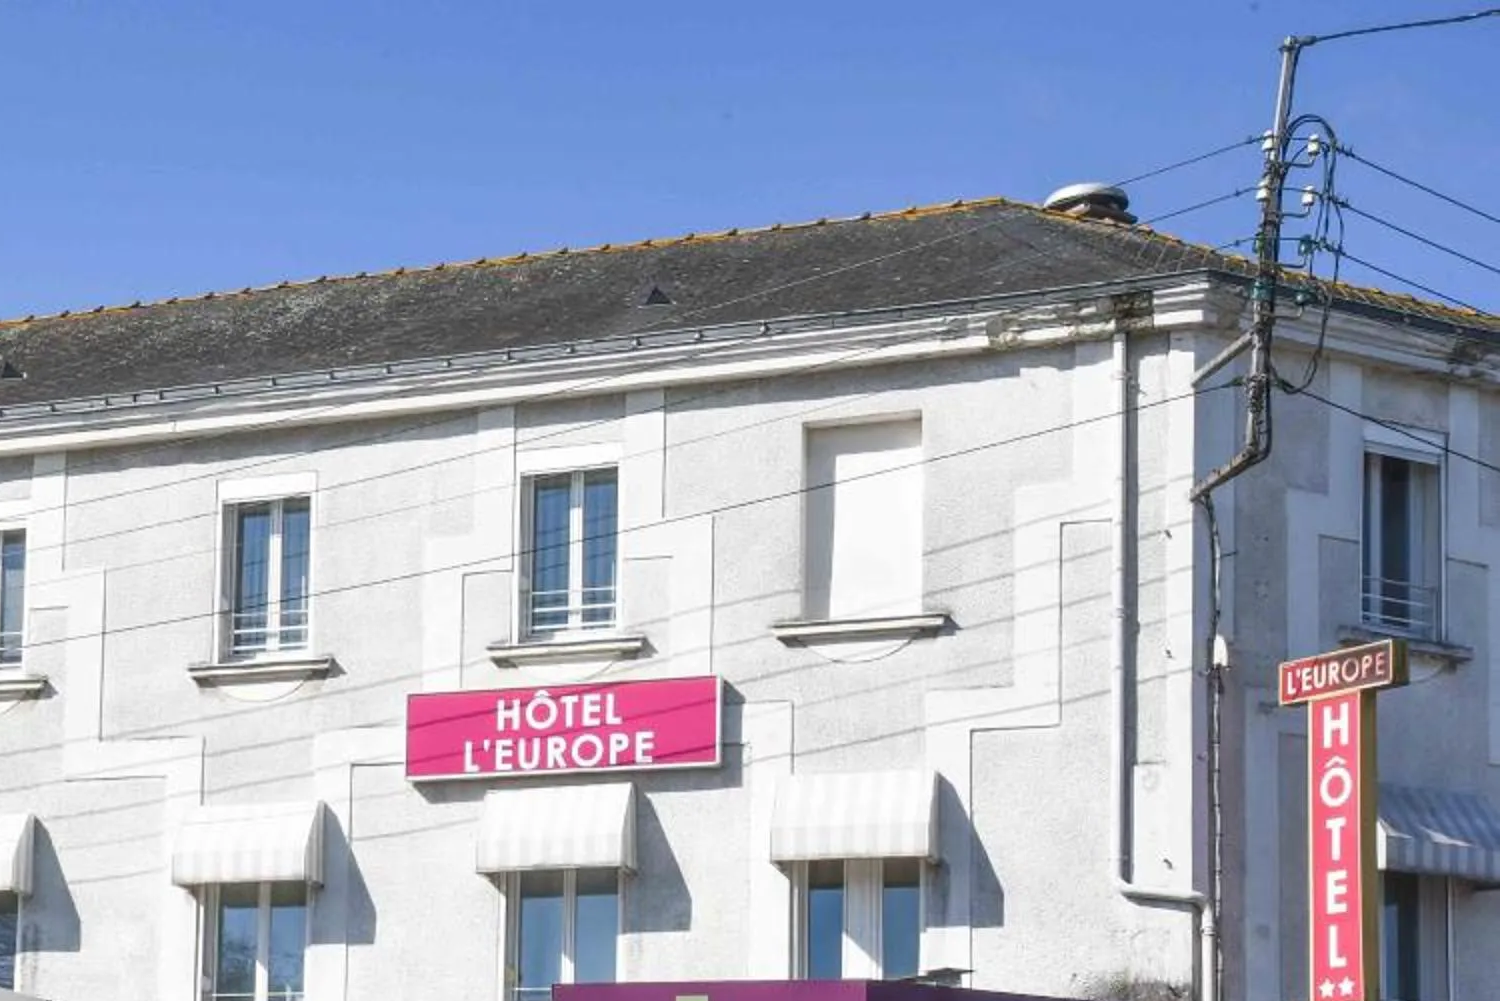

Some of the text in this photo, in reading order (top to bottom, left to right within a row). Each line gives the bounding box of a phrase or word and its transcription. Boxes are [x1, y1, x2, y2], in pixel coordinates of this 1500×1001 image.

[1286, 651, 1386, 695] L'EUROPE
[497, 690, 622, 731] HÔTEL
[464, 731, 654, 773] L'EUROPE
[1319, 702, 1352, 968] HÔTEL
